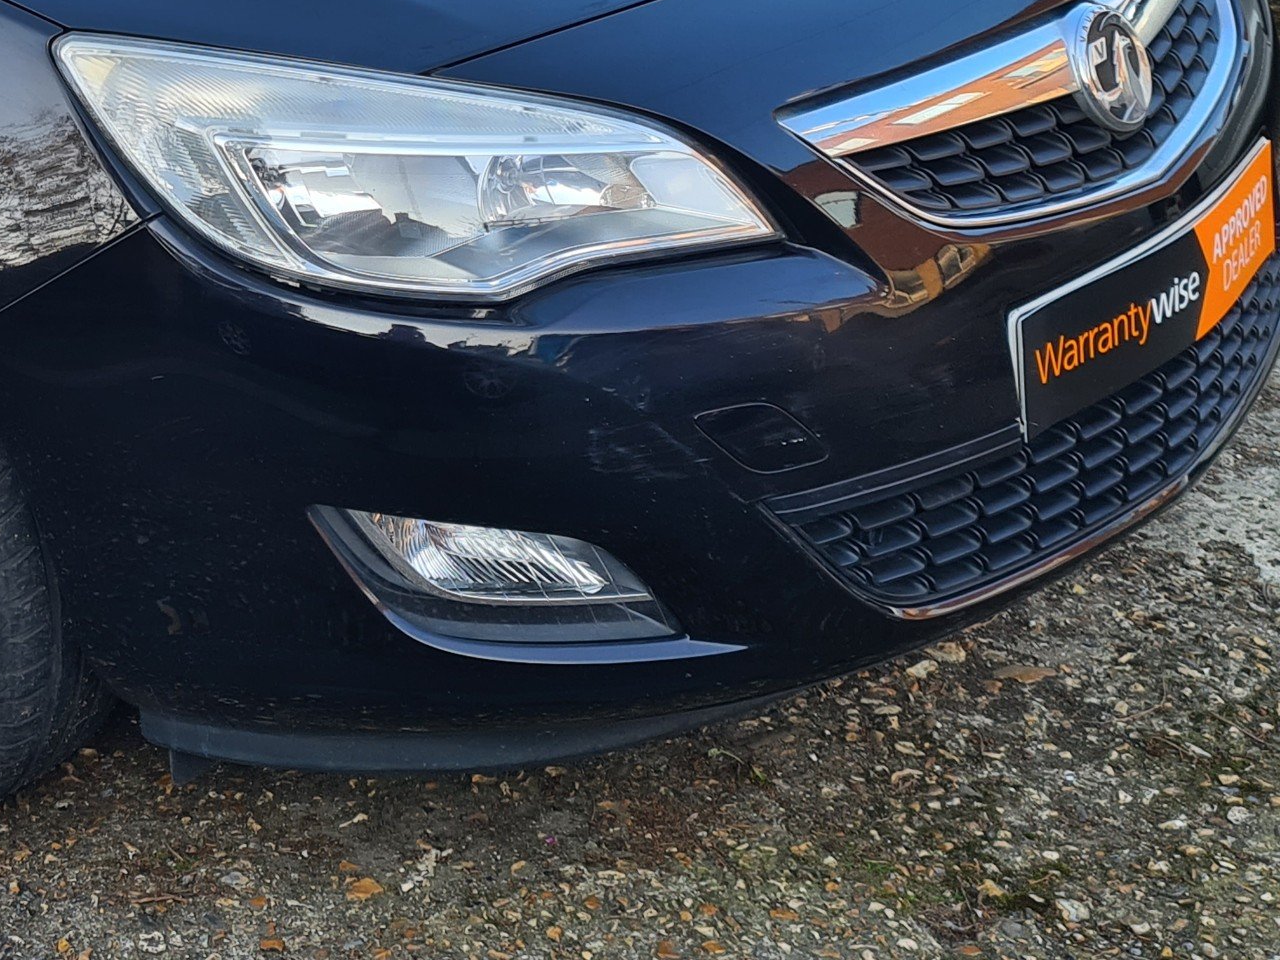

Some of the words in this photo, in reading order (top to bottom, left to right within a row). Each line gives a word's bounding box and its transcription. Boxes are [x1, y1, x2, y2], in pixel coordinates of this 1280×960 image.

[1212, 174, 1268, 265] APPROVED
[1223, 220, 1261, 291] DEALER
[1035, 270, 1200, 384] Warrantywise
